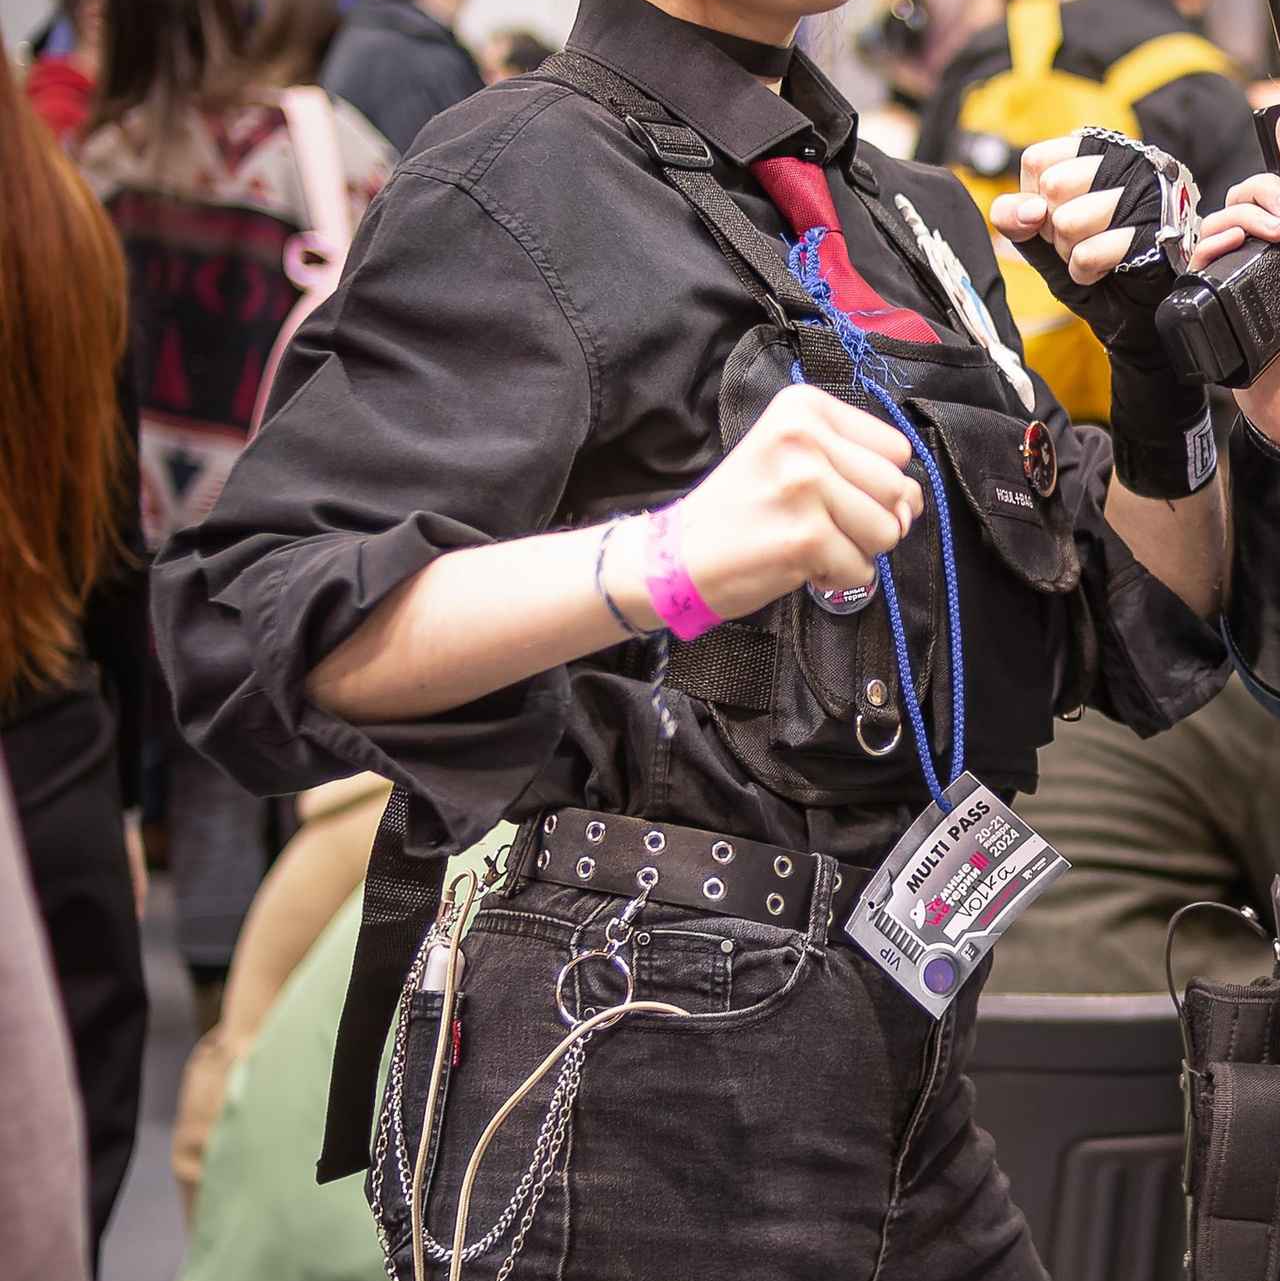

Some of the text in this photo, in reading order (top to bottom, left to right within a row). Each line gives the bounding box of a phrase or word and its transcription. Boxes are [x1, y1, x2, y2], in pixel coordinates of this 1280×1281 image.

[974, 815, 1005, 844] 20-21
[983, 822, 1011, 849] января
[989, 828, 1020, 858] 2024
[906, 801, 990, 894] MULTI PASS
[880, 948, 901, 971] VIP
